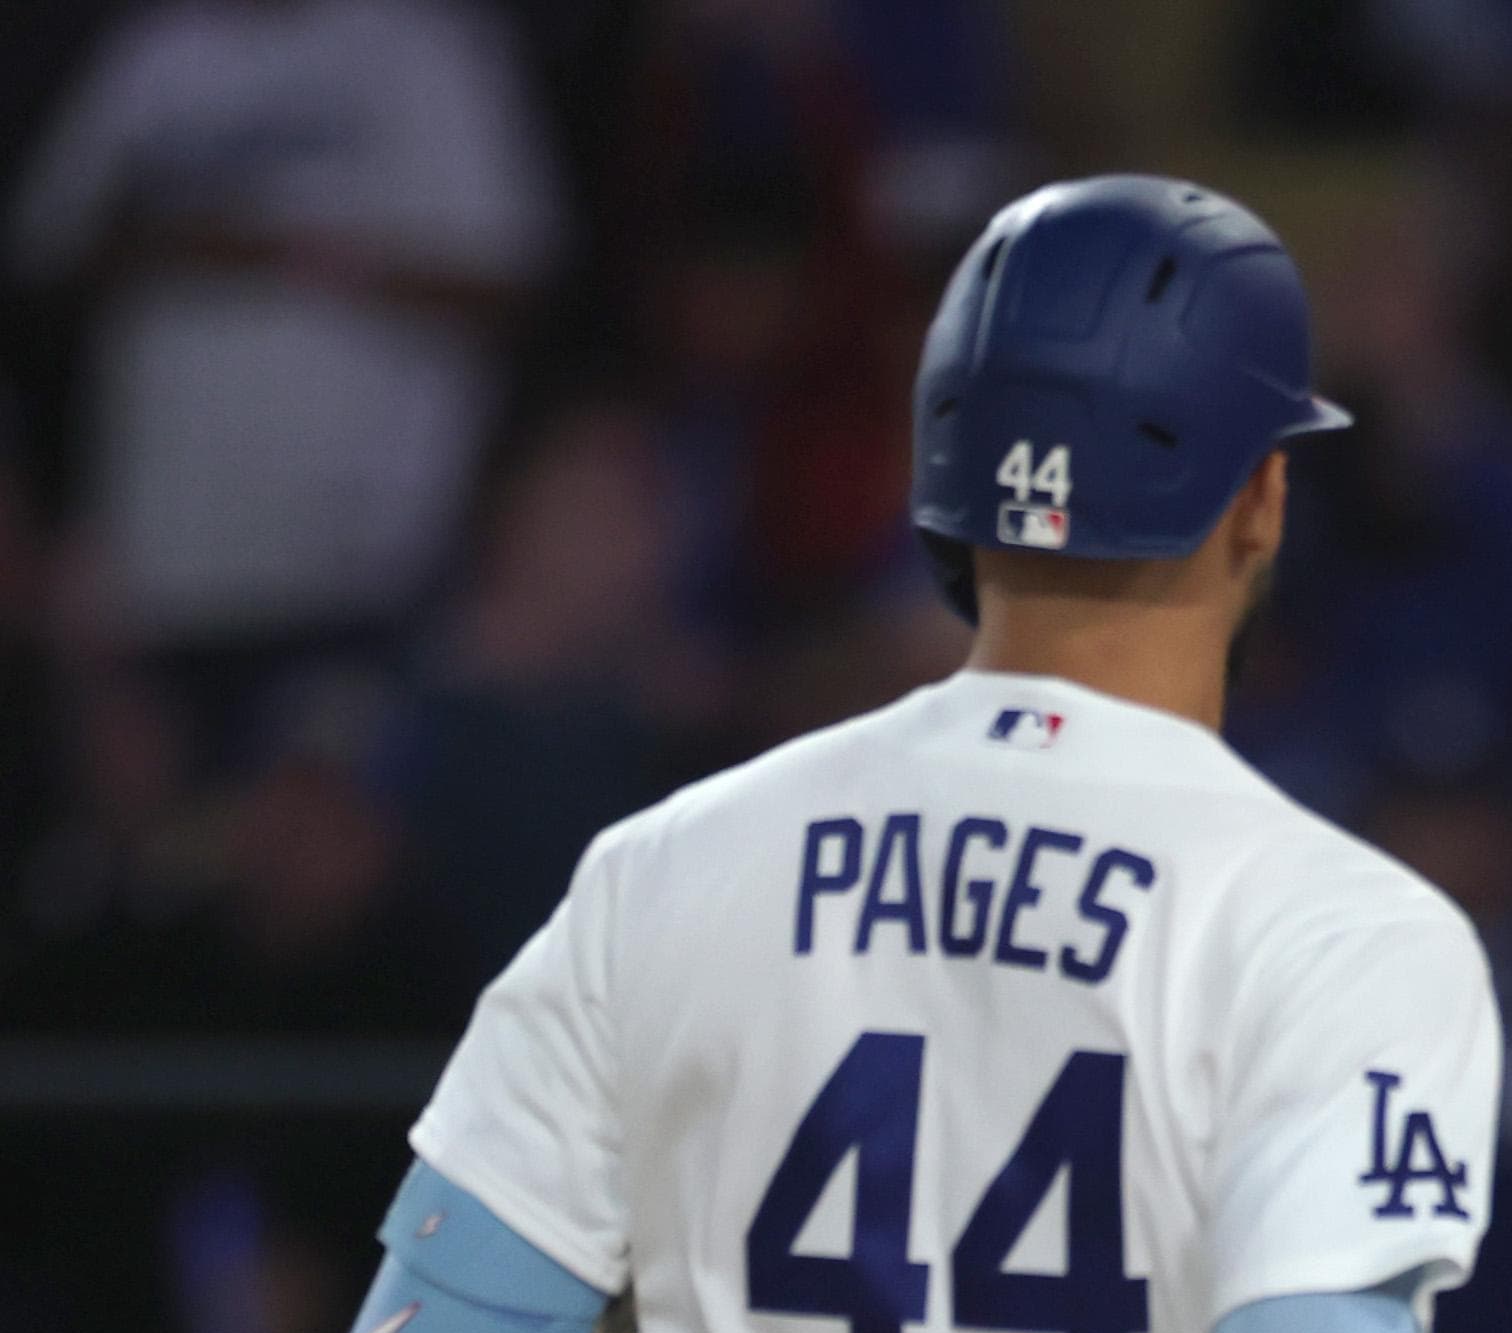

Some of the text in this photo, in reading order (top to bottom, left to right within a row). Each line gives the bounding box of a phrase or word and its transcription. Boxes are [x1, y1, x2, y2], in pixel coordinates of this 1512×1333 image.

[997, 440, 1071, 505] 44
[793, 813, 1156, 985] PAGES
[1357, 1070, 1471, 1221] LA
